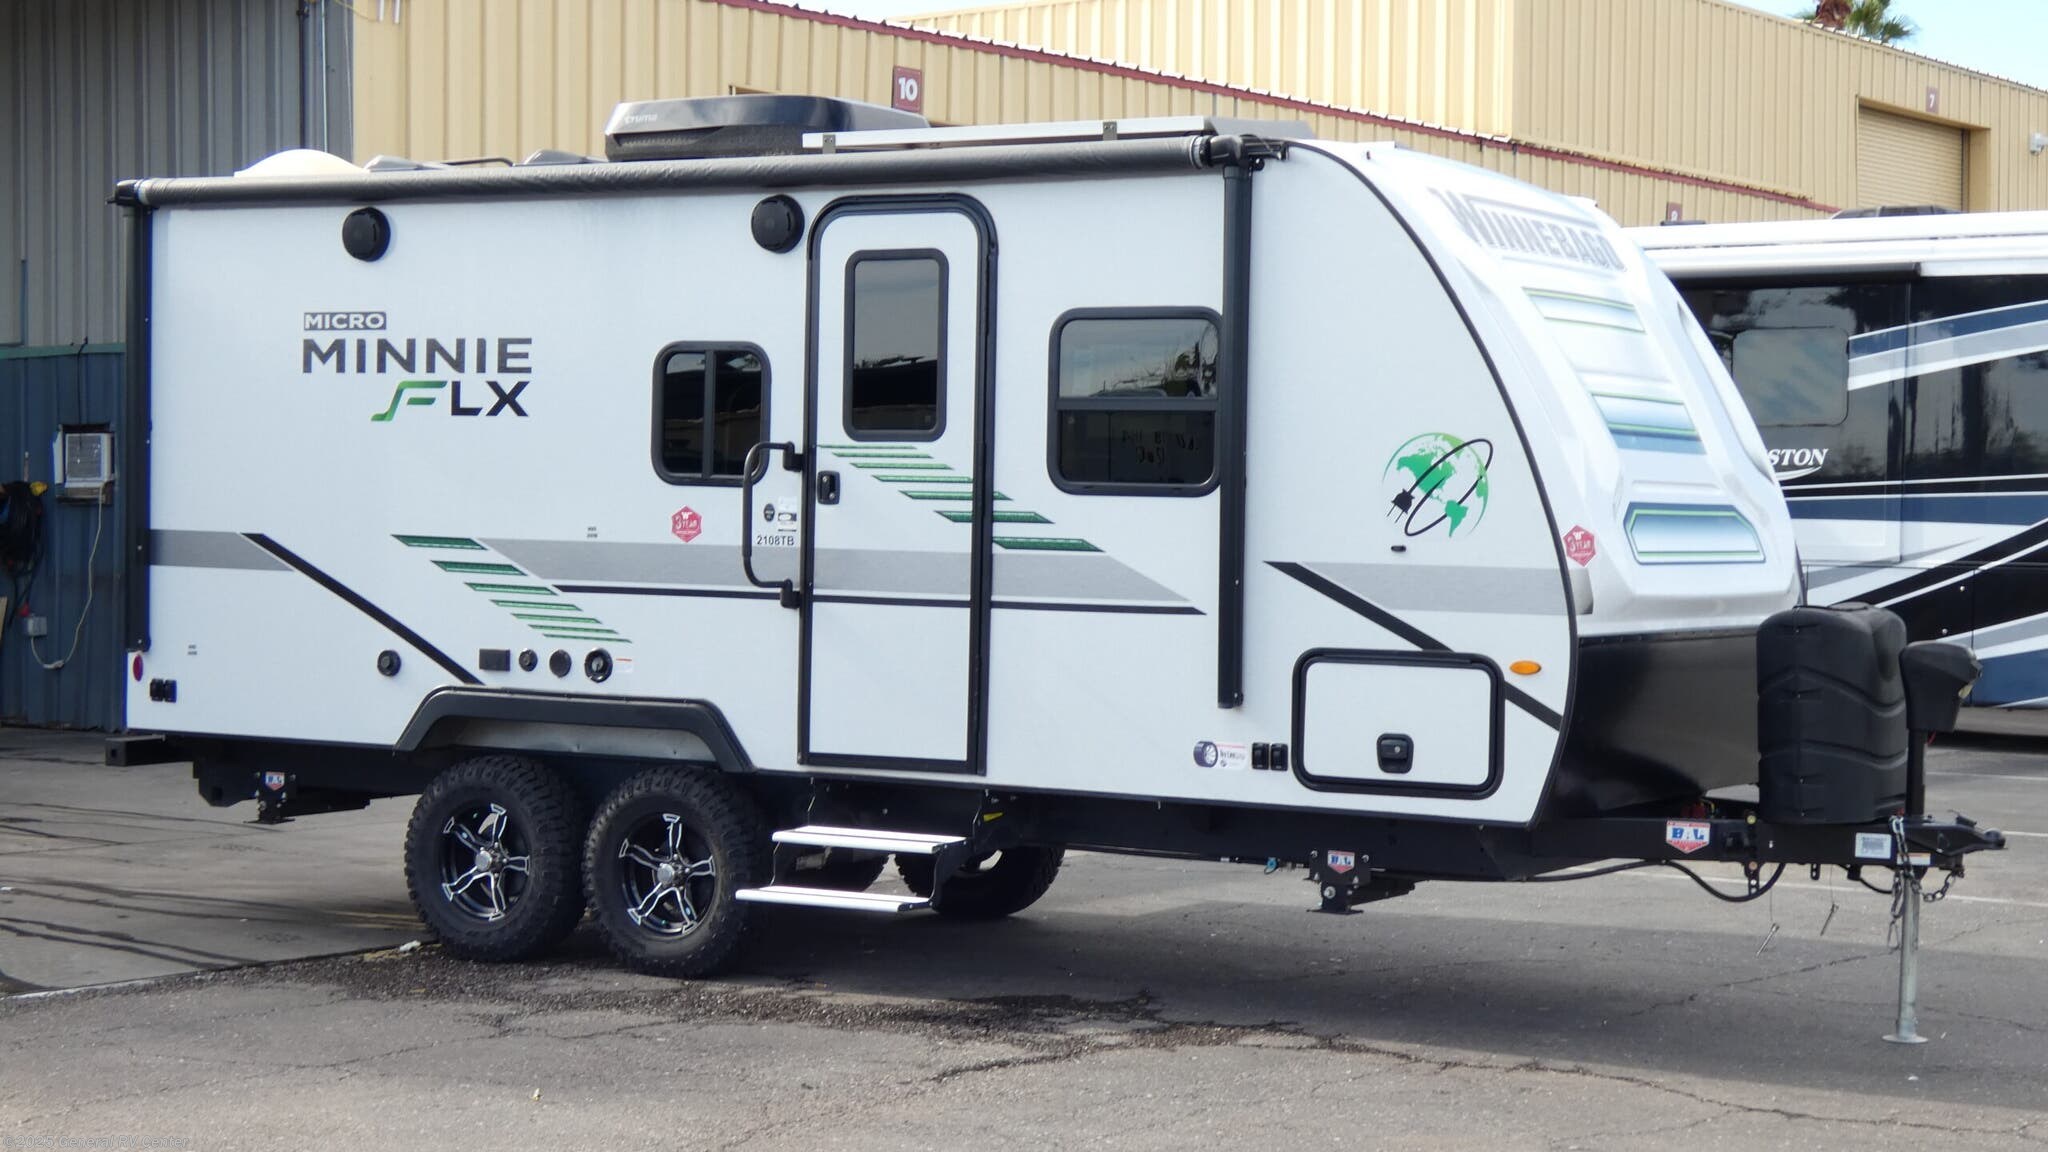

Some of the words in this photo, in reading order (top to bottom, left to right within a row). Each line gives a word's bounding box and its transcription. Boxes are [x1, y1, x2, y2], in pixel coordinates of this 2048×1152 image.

[898, 77, 918, 102] 10
[1929, 93, 1936, 108] 7
[1426, 187, 1628, 272] WINNEBAGO
[304, 313, 385, 329] MICRO
[302, 337, 533, 374] MINNIE
[371, 380, 531, 421] FLX
[756, 535, 795, 546] 2108TB
